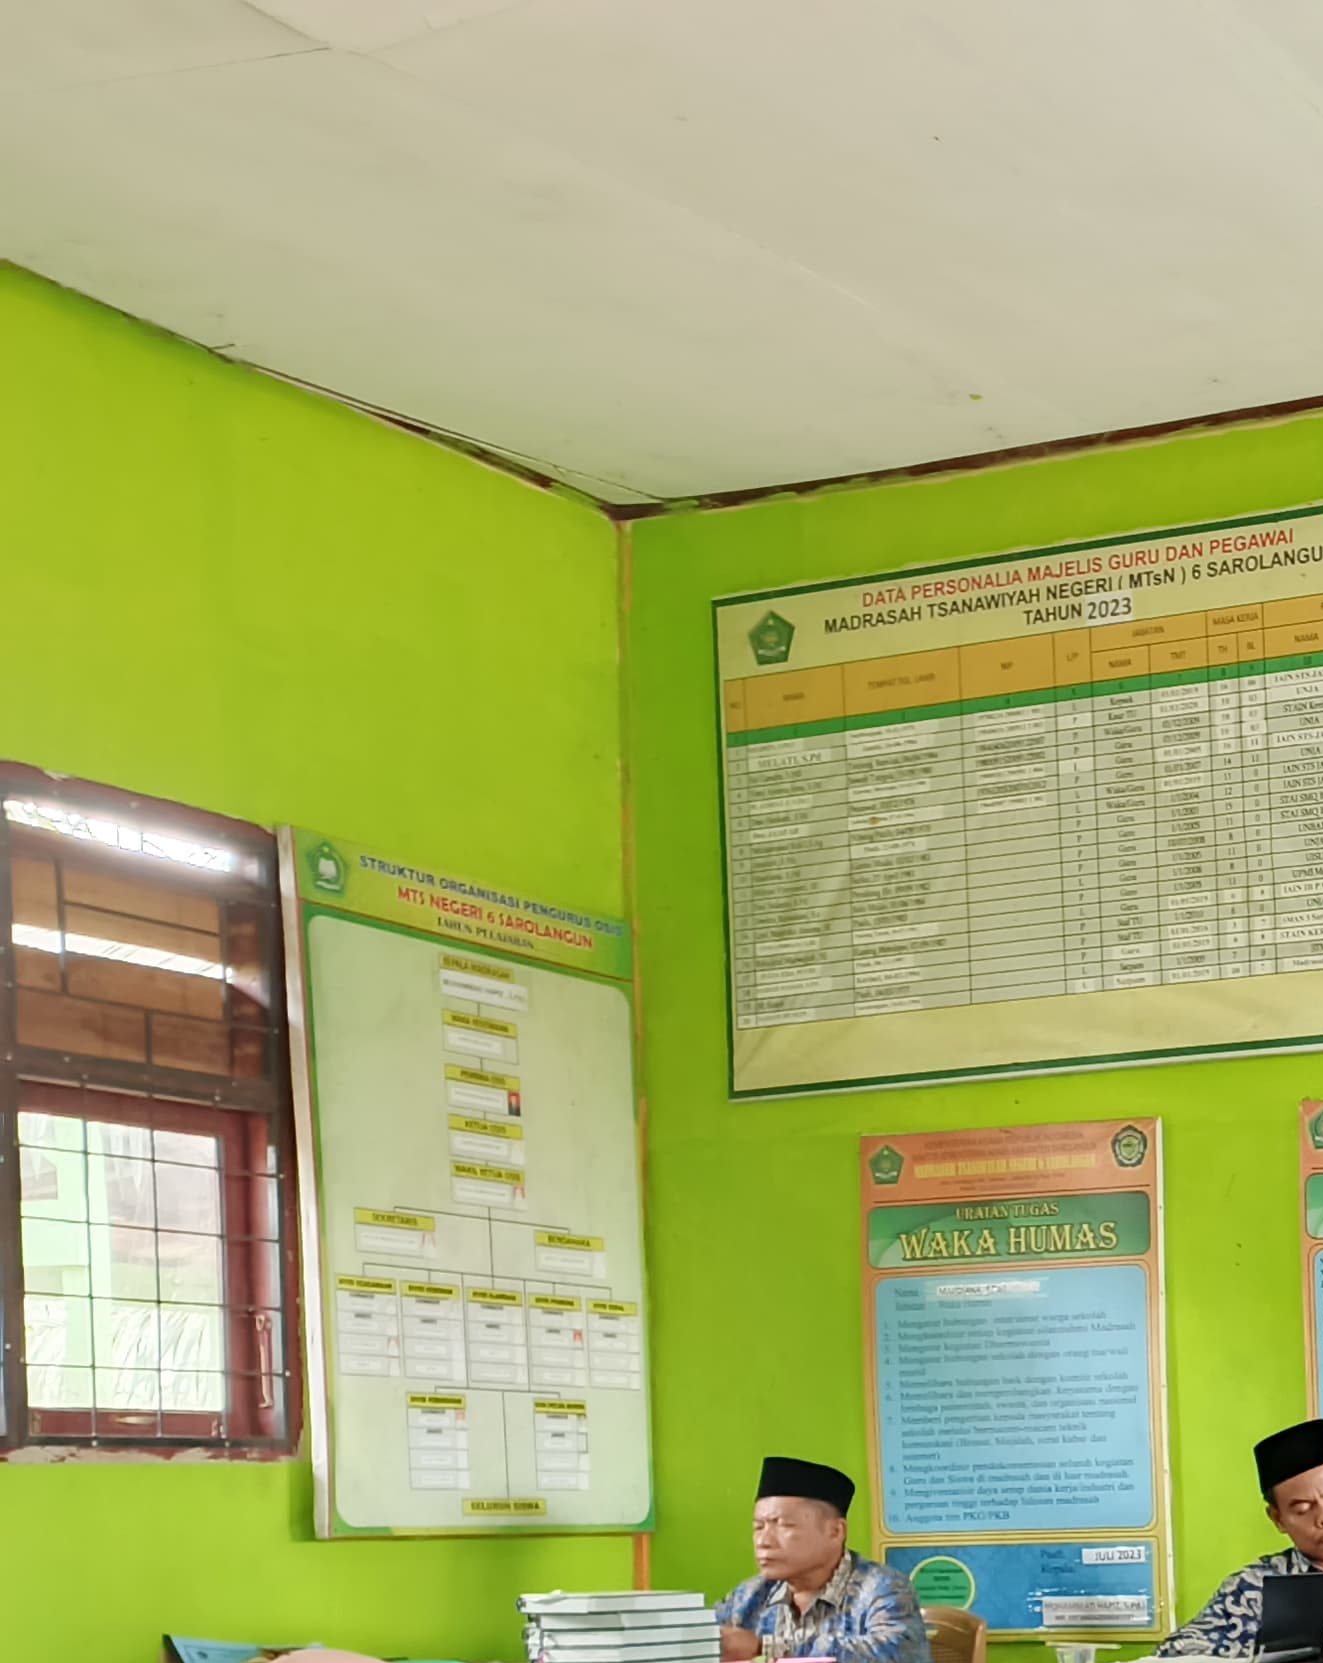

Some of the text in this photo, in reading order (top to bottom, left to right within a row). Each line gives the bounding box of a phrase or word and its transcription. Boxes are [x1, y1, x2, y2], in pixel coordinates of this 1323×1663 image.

[862, 528, 1292, 607] DATA PERSONALIA MAJELIS GURU DAN PEGAWAI
[825, 606, 921, 631] MADRASAH
[926, 588, 1040, 617] TSANAWIYAH
[1046, 577, 1112, 600] NEGERI
[1129, 567, 1174, 588] MTsN
[1191, 563, 1201, 580] 6
[1023, 597, 1131, 624] TAHUN 2023
[430, 894, 483, 920] NEGERI
[499, 912, 592, 949] SAROLANGUN
[897, 1222, 1116, 1258] WAKA HUMAS
